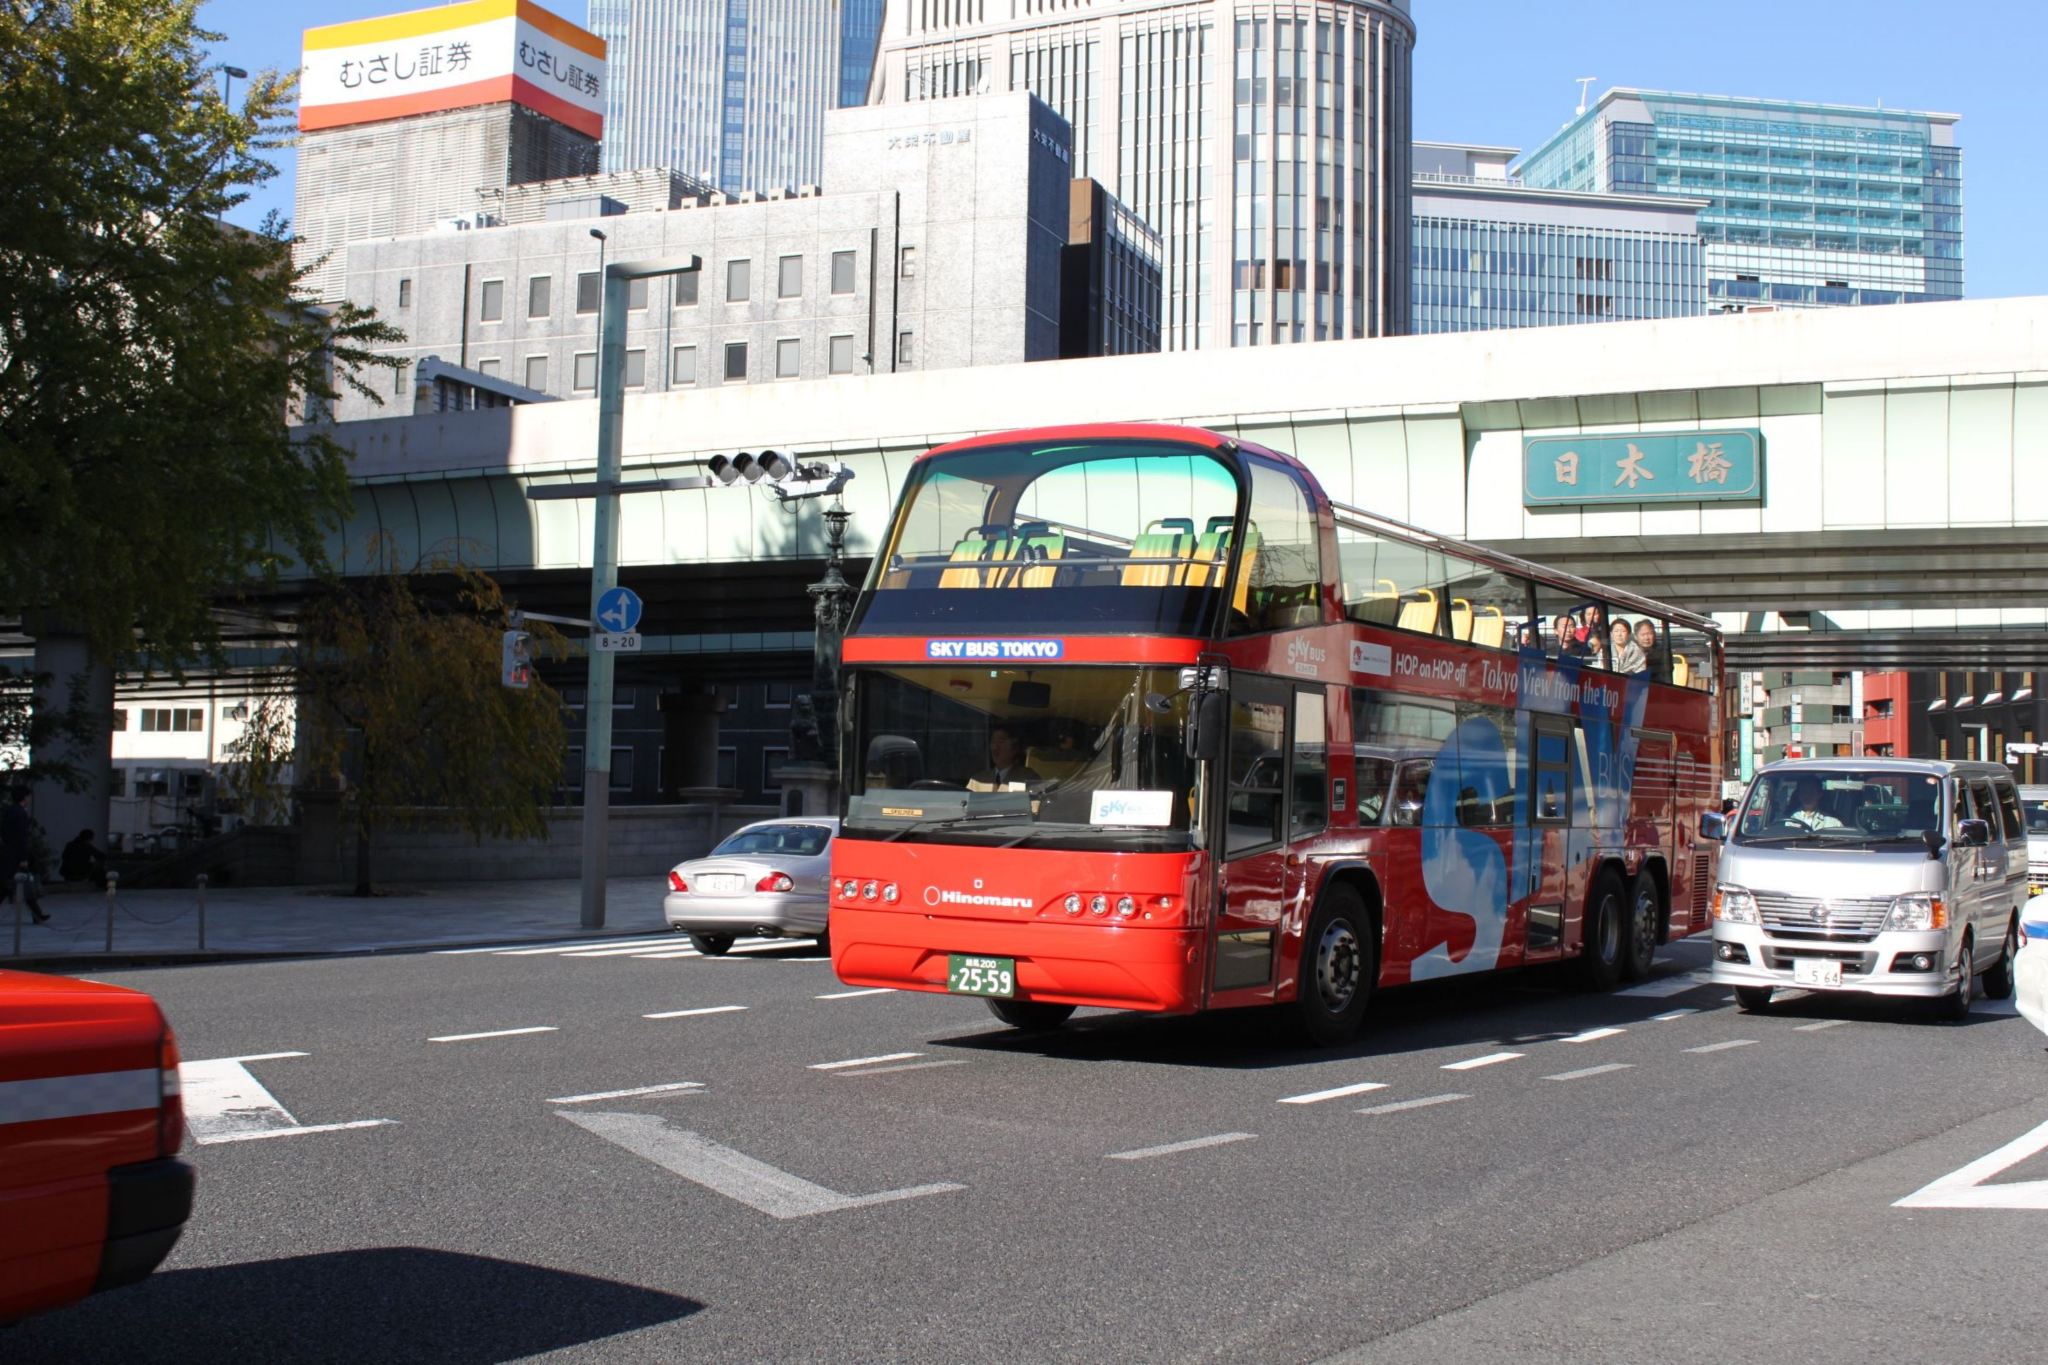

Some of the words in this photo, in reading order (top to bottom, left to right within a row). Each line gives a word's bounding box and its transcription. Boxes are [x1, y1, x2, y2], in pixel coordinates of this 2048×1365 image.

[339, 41, 472, 89] むさし証券
[519, 40, 600, 98] むさし証券
[1554, 441, 1732, 489] 日本橋
[930, 641, 965, 657] SKY
[966, 641, 999, 657] BUS
[1001, 641, 1058, 658] TOKYO
[1287, 635, 1310, 665] SKY
[1310, 647, 1326, 662] BUS
[1395, 652, 1419, 675] HOP
[1419, 663, 1431, 677] on
[1432, 658, 1454, 681] HOP
[1455, 663, 1468, 687] off
[1482, 659, 1518, 700] Tokyo
[1523, 667, 1552, 697] View
[1554, 671, 1580, 702] from
[1583, 677, 1600, 705] the
[1602, 682, 1619, 716] top
[1598, 751, 1632, 800] BUS
[942, 890, 1033, 909] Hinomaru
[959, 968, 1011, 993] 25-59
